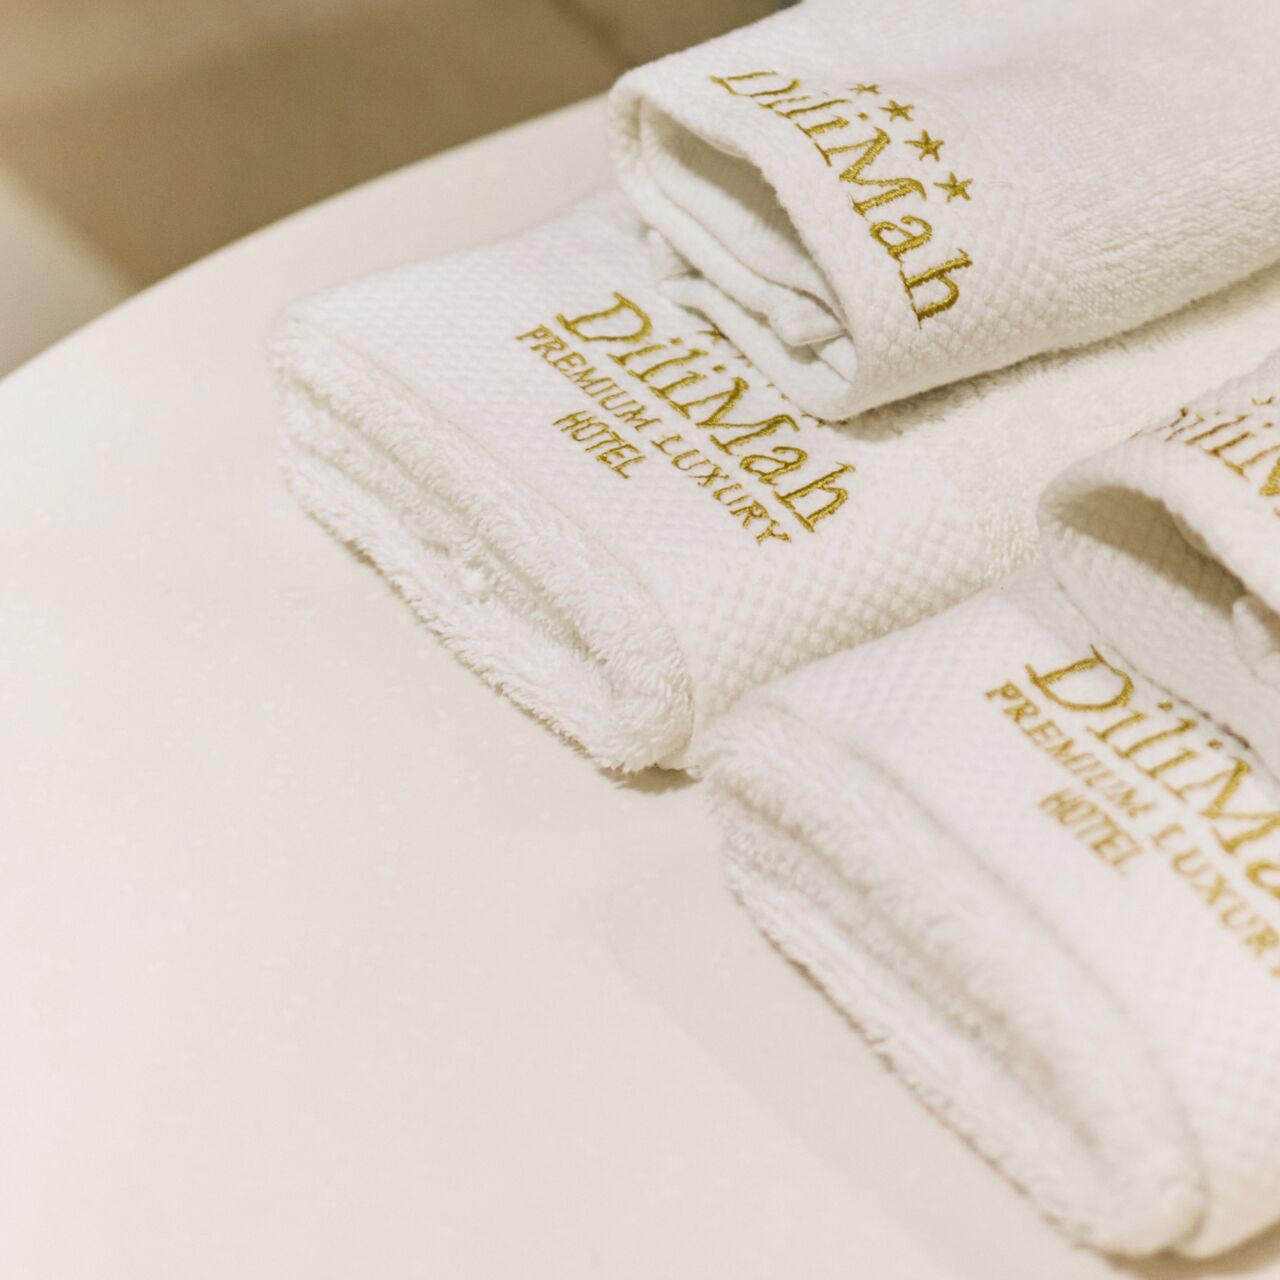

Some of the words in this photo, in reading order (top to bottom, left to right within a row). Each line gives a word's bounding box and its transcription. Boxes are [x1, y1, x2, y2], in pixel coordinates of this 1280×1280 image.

[516, 323, 662, 434] PREMIUM
[651, 432, 793, 545] LUXURY
[551, 409, 652, 480] HOTEL
[556, 290, 857, 534] DiliMah
[985, 680, 1157, 820] PREMIUM
[1037, 785, 1149, 878] HOTEL
